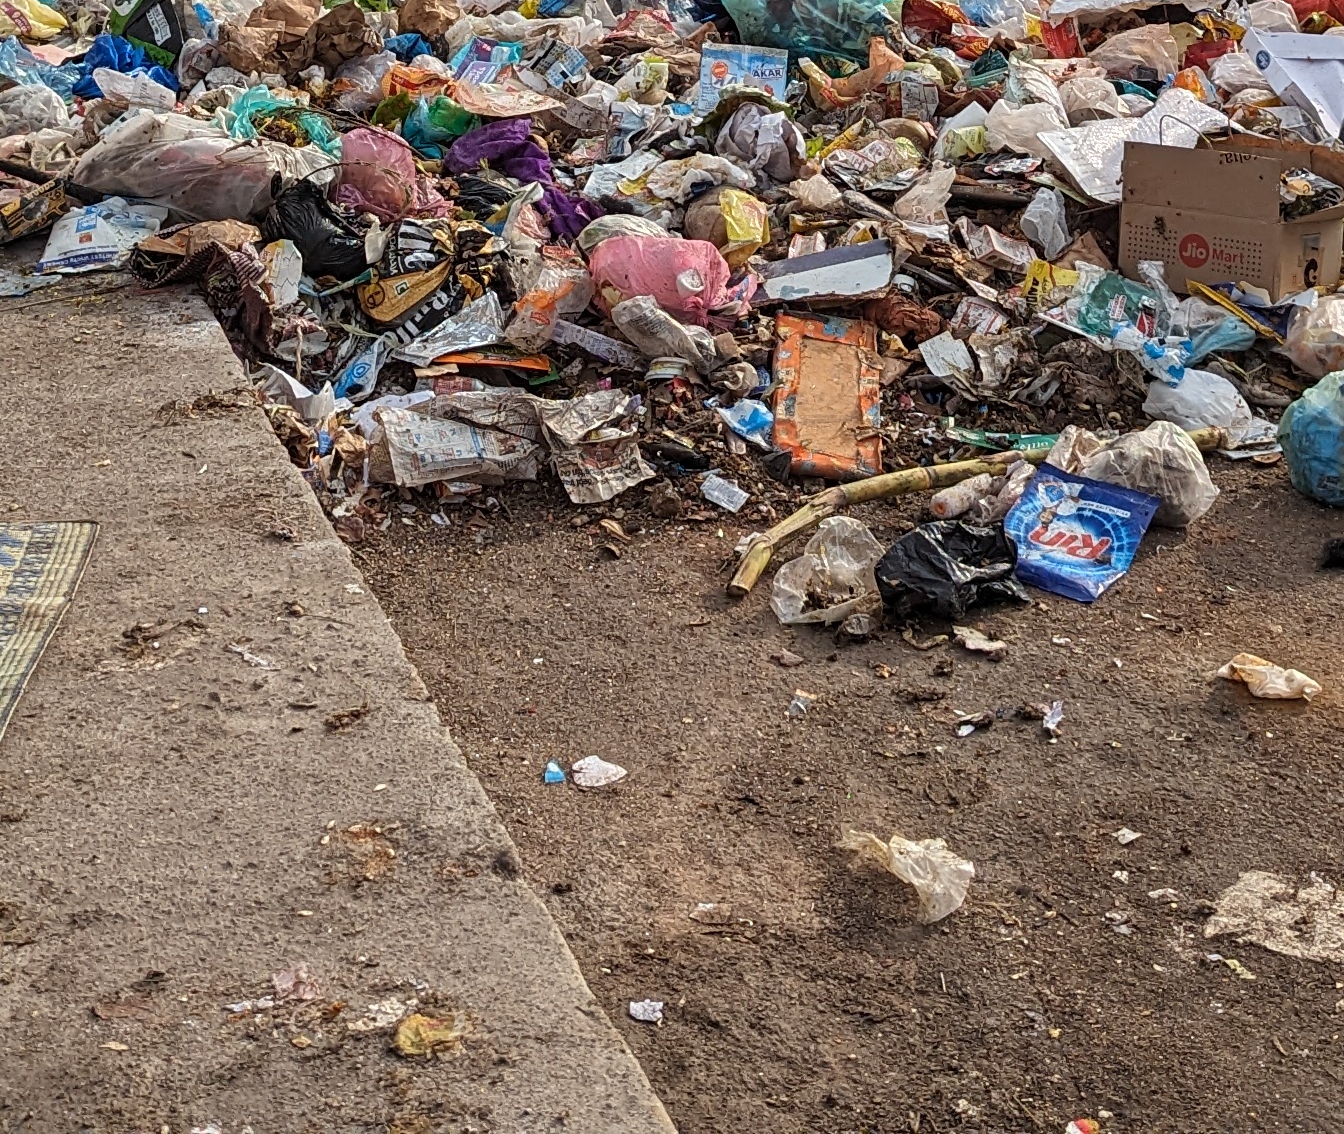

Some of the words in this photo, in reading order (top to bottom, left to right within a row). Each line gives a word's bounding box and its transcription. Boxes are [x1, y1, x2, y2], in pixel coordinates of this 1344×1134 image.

[753, 68, 783, 78] AKAR
[1181, 241, 1208, 260] Jio
[1211, 247, 1246, 265] Mart
[1028, 524, 1113, 561] Rin
